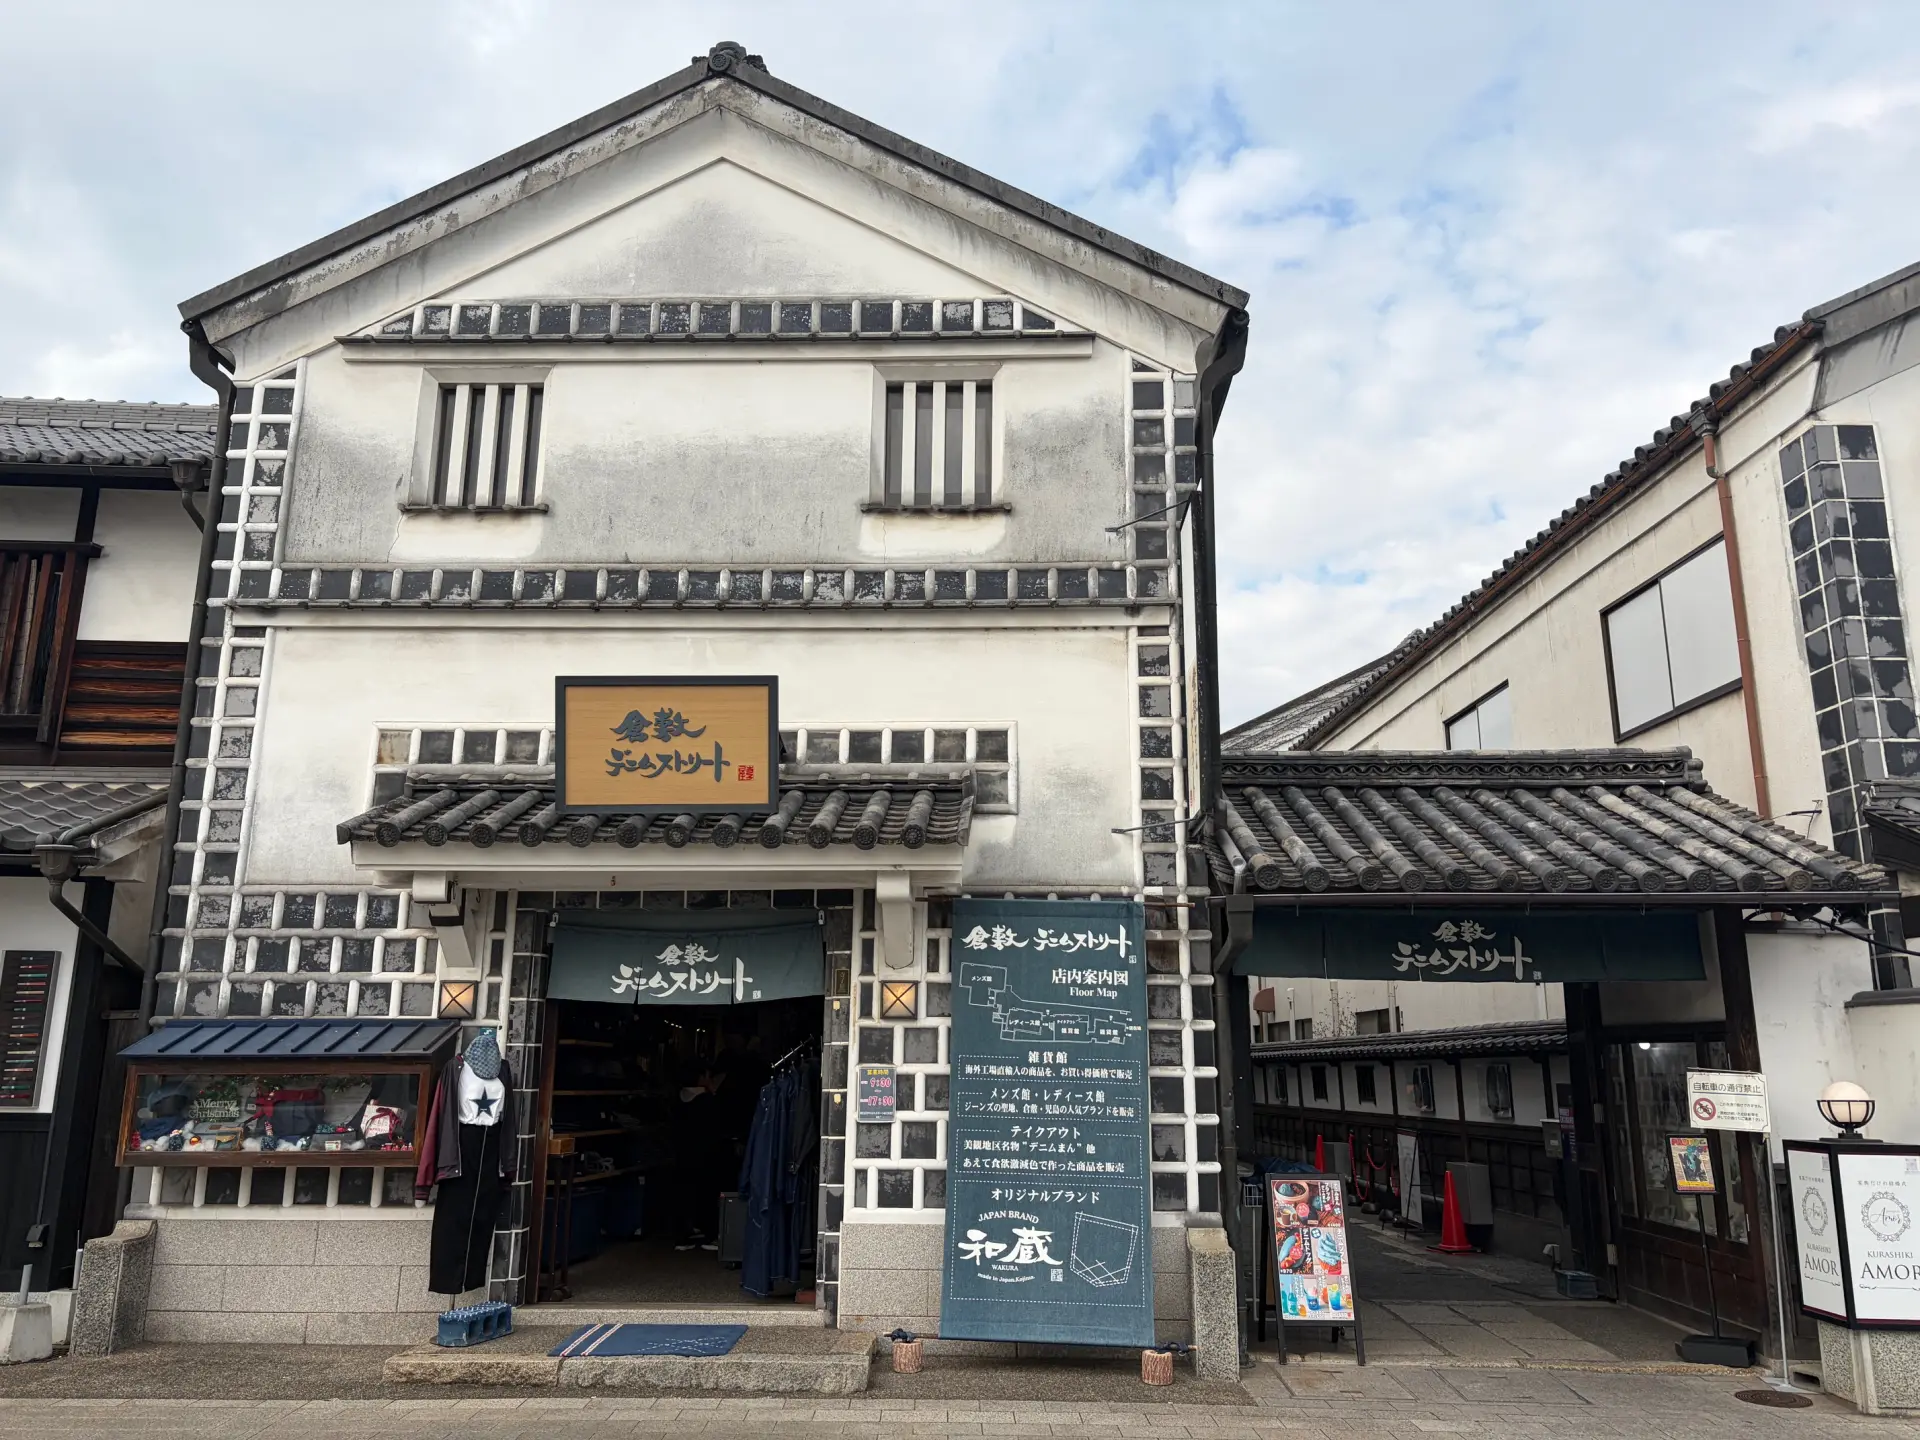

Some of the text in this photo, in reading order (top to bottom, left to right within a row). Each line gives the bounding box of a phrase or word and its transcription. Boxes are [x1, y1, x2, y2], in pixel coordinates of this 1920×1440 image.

[609, 707, 707, 743] 倉敷
[605, 740, 730, 783] デニムストリート
[1431, 919, 1496, 943] 倉敷
[960, 924, 1133, 959] 倉敷 デニムストリート
[654, 942, 720, 966] 倉敷
[1391, 936, 1533, 980] デニムストリート
[610, 957, 754, 1001] デニムストリート
[1051, 968, 1129, 986] 店内案内図
[1069, 987, 1118, 1000] Floor Map
[1028, 1051, 1068, 1064] 雑貨館
[990, 1088, 1106, 1103] メンズ館・レディース館
[1693, 1082, 1762, 1094] 自転車の通行禁止
[199, 1098, 234, 1109] Merry
[188, 1107, 240, 1118] Christmas
[1010, 1125, 1082, 1140] テイクアウト
[991, 1188, 1101, 1204] オリジナルブランド
[978, 1210, 1040, 1224] JAPAN BRAND
[957, 1226, 1064, 1266] 和蔵
[1806, 1242, 1832, 1254] KURASHIKI
[1867, 1251, 1914, 1259] KURASHIKI
[991, 1264, 1019, 1272] WAKURA
[1804, 1254, 1840, 1277] AMOR
